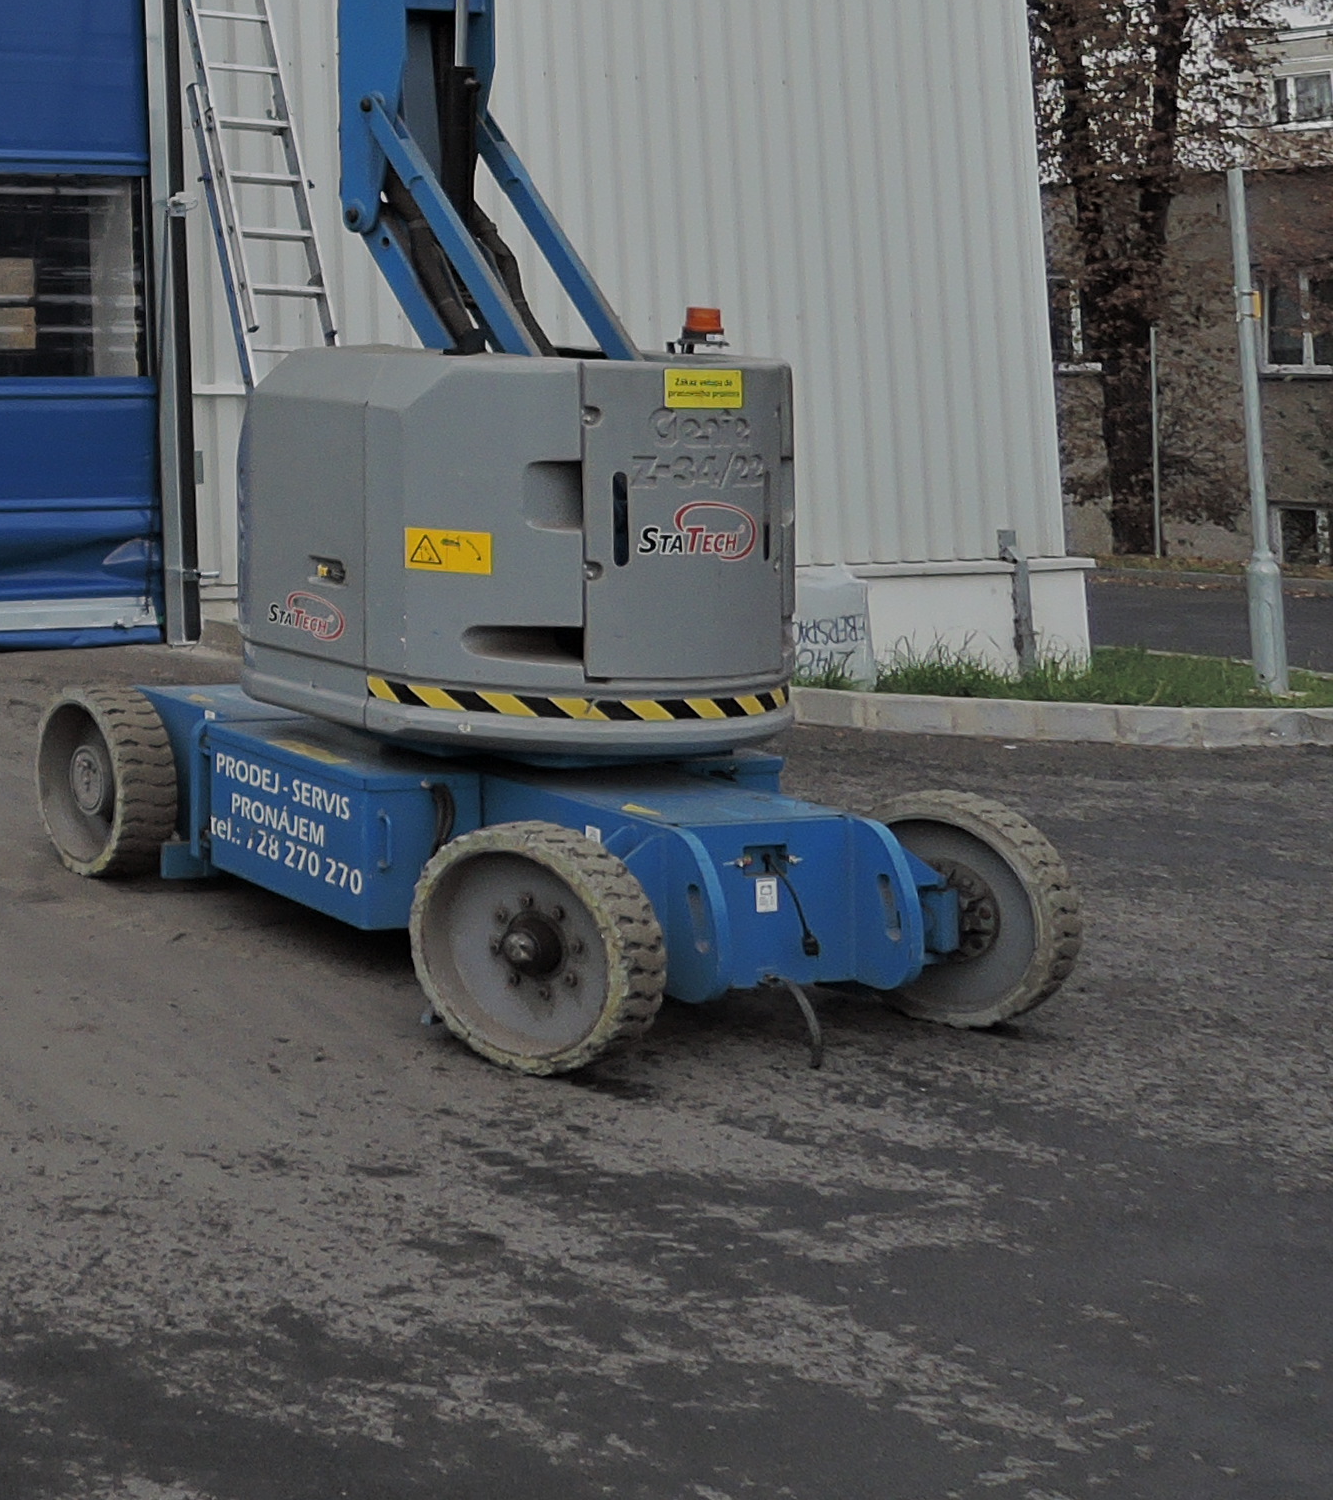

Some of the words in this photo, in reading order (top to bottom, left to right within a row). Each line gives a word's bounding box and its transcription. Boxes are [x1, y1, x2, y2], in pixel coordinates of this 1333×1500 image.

[216, 752, 280, 795] PRODEJ
[292, 779, 350, 821] SERVIS
[231, 792, 325, 847] PRONÁJEM
[284, 840, 320, 878] 270
[324, 857, 363, 896] 270
